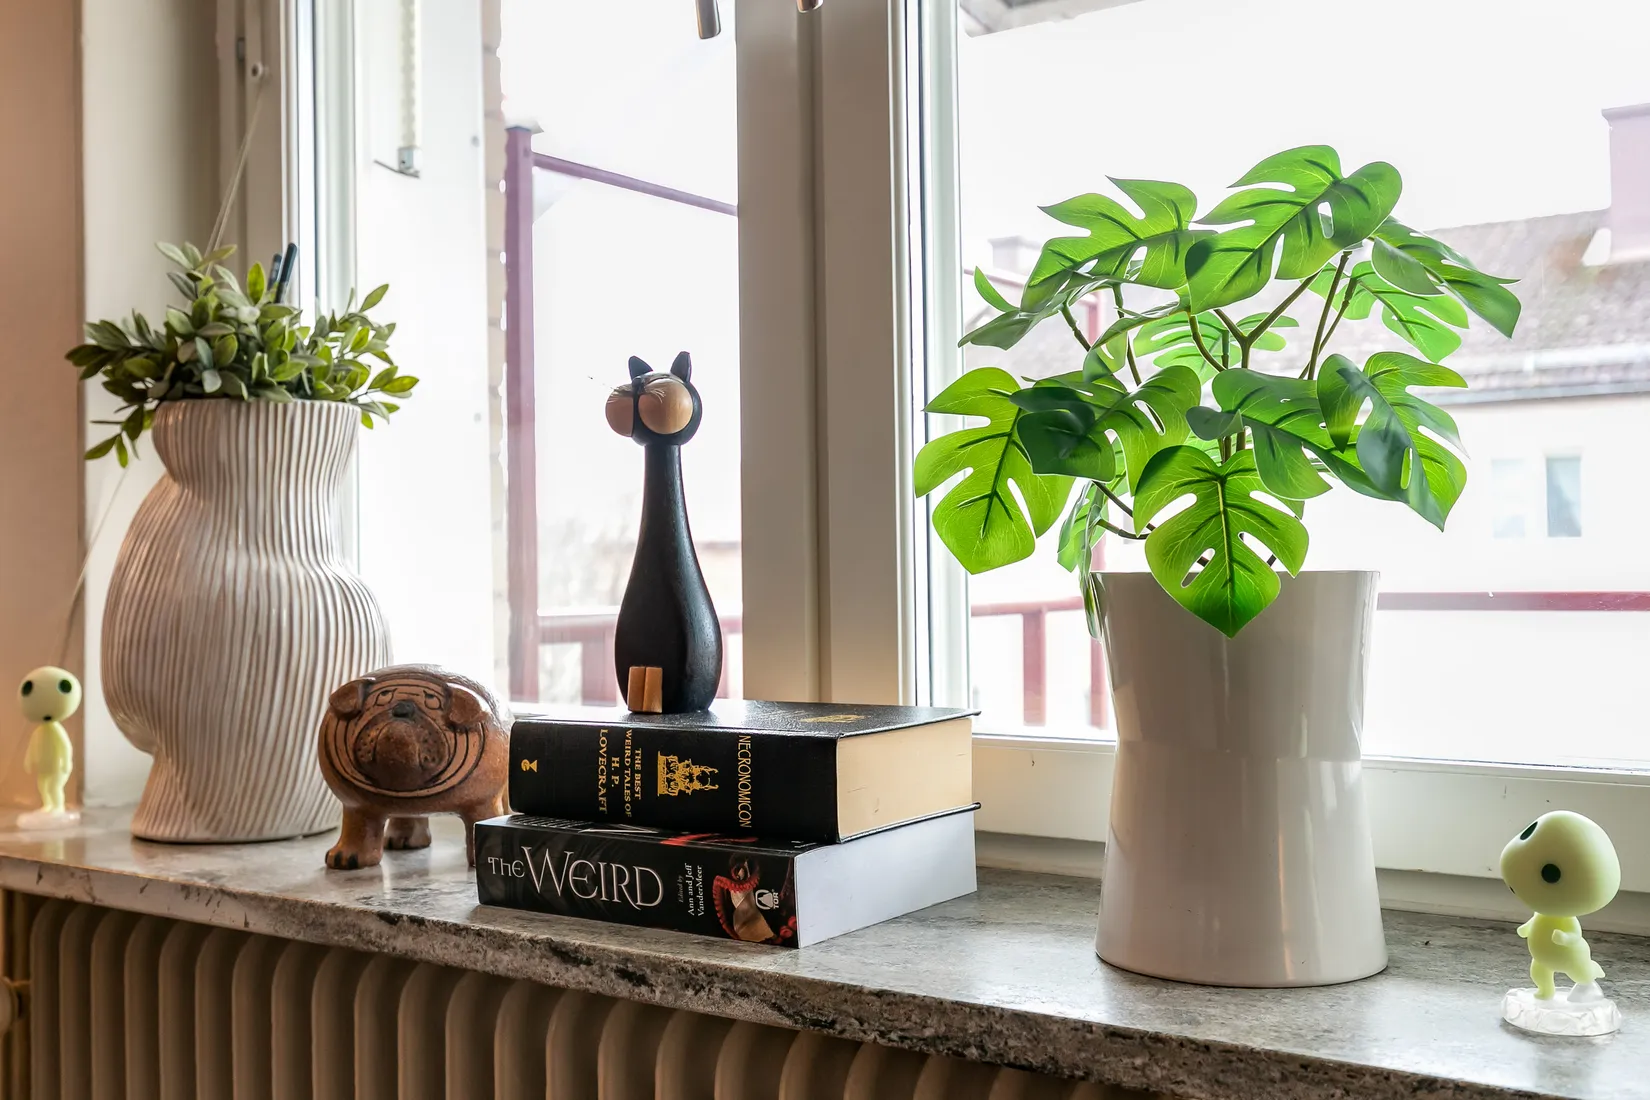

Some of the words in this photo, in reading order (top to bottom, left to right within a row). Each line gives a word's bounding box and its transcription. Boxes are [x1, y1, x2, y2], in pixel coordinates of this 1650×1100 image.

[624, 729, 633, 766] WEIRD
[634, 748, 642, 771] THE
[598, 729, 608, 814] LOVECRAFT
[611, 757, 620, 771] H.
[611, 775, 620, 788] P.
[624, 768, 632, 802] TALES
[634, 773, 642, 800] BEST
[738, 735, 752, 828] NECRONOMICON
[624, 803, 633, 817] OF
[521, 846, 664, 910] WEIRD
[684, 863, 694, 880] Jeff
[686, 879, 694, 896] and
[696, 865, 705, 916] VanderMeer
[687, 898, 695, 916] Ann
